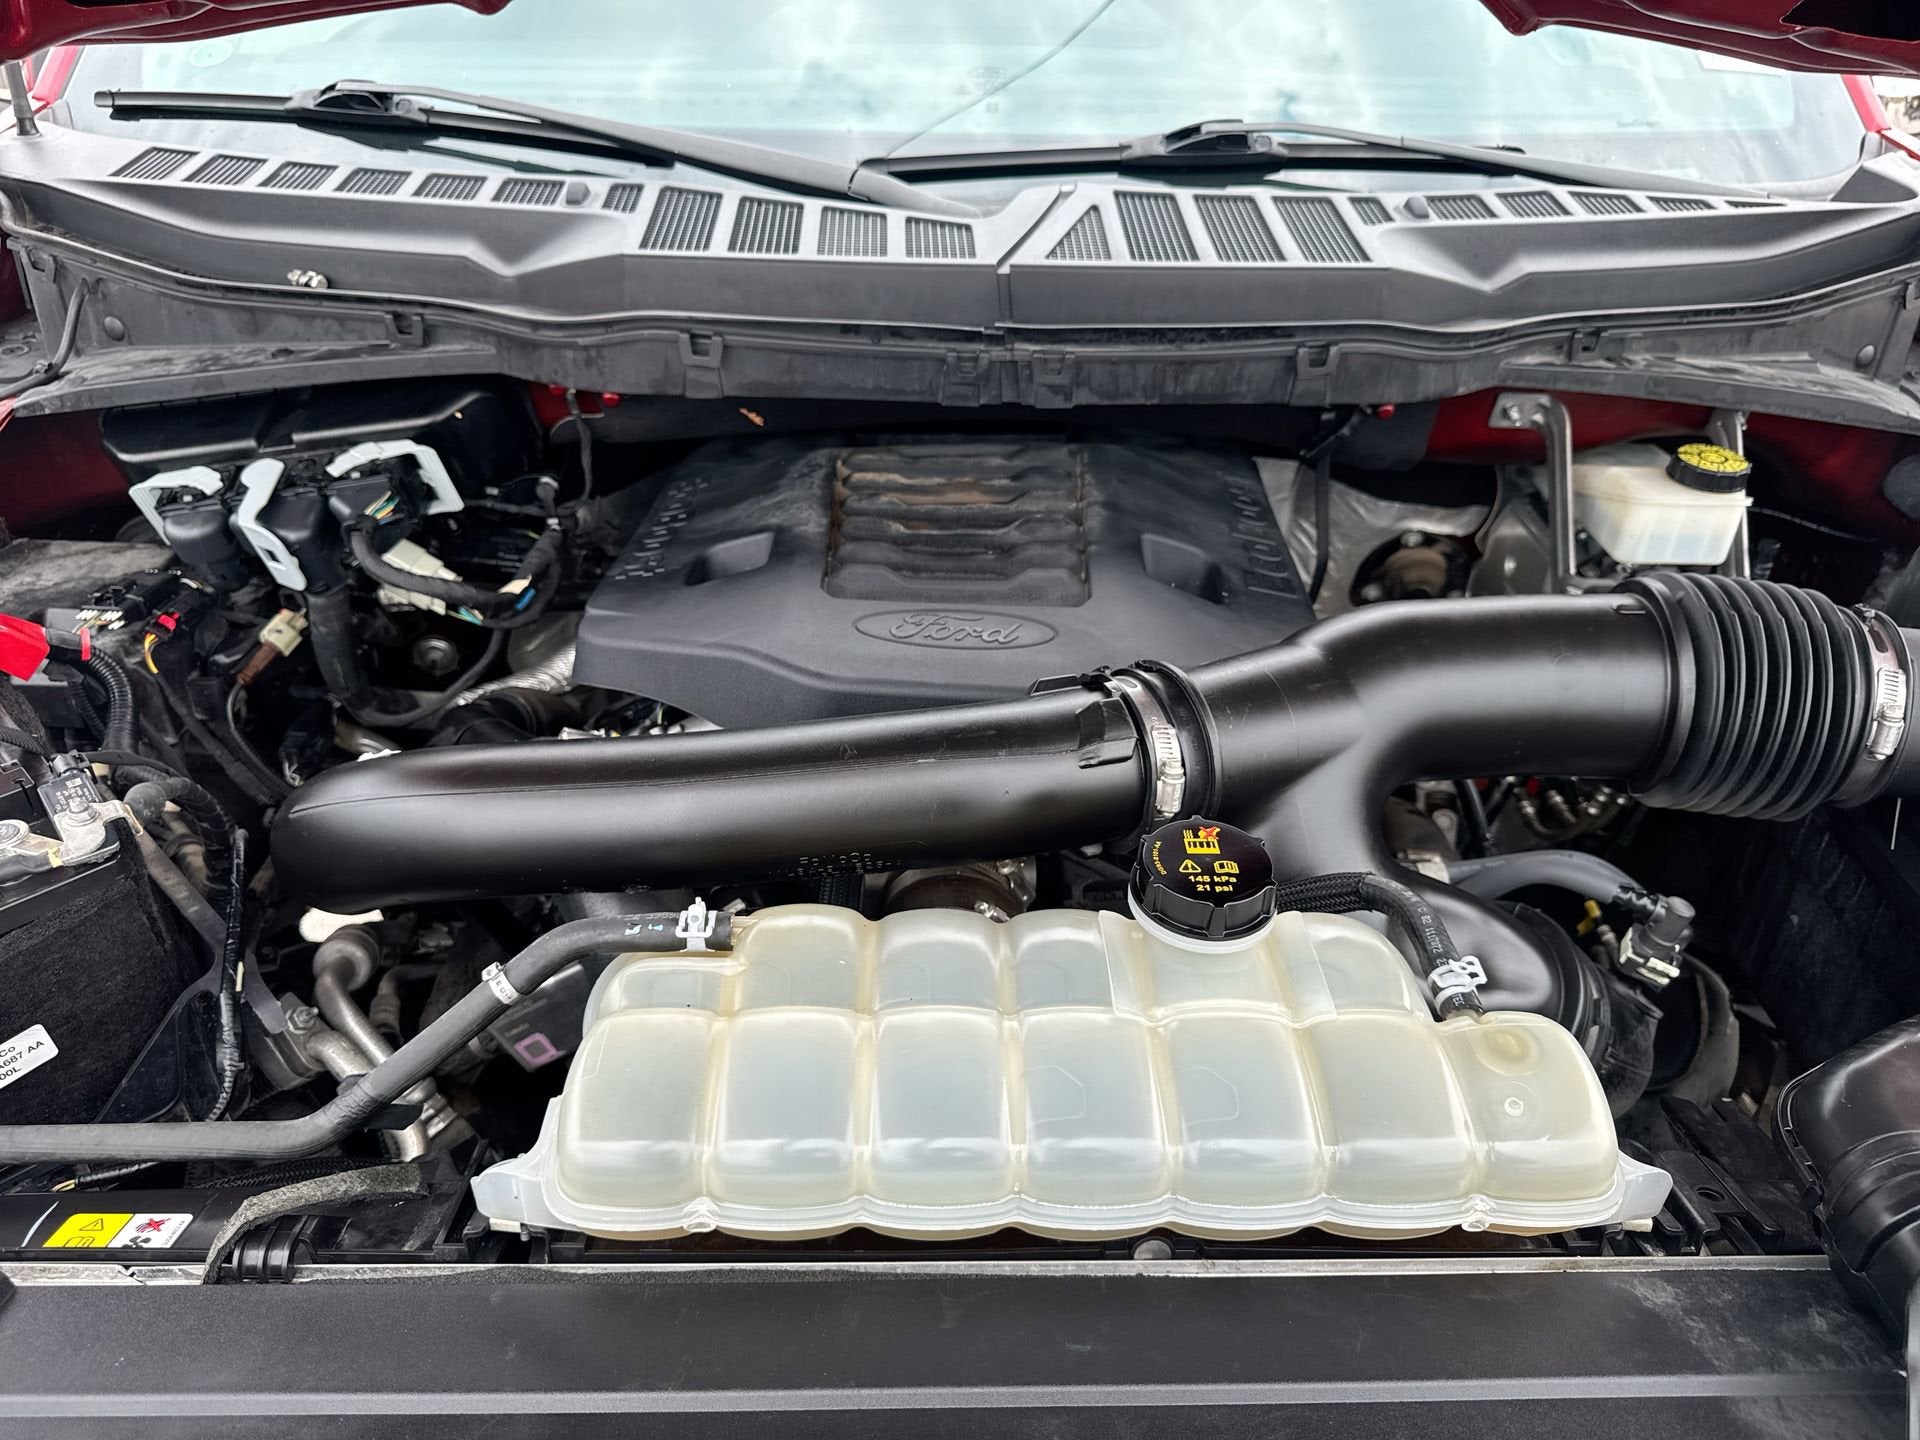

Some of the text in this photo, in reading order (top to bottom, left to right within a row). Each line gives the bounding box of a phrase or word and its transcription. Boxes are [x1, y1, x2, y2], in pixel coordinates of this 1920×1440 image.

[889, 613, 1023, 645] Ford
[1213, 875, 1237, 883] kPa
[1214, 884, 1233, 893] psi
[28, 1041, 45, 1054] AA
